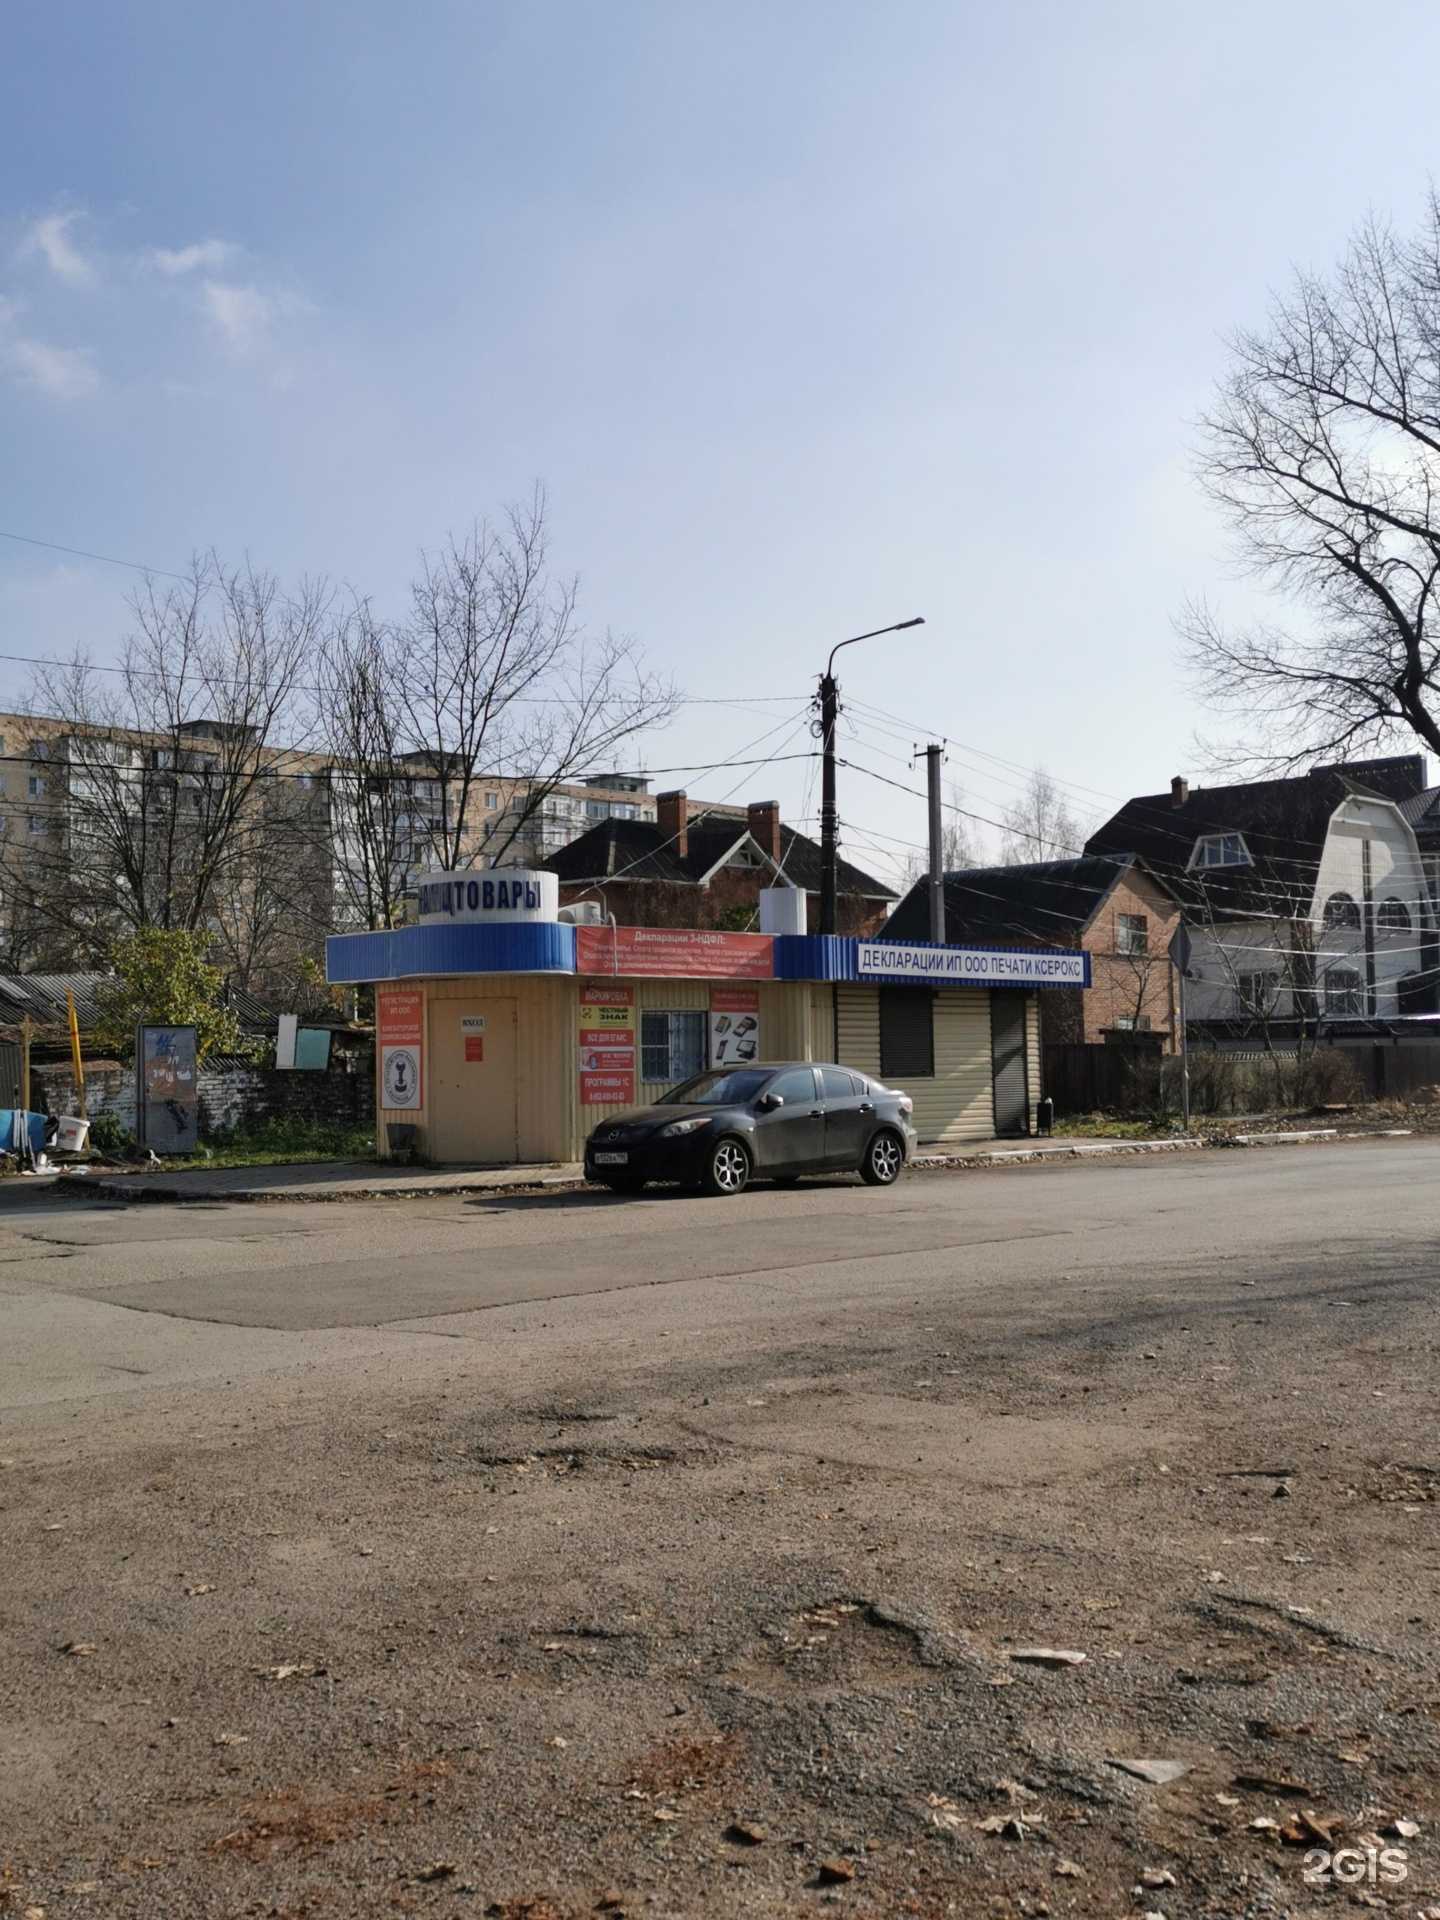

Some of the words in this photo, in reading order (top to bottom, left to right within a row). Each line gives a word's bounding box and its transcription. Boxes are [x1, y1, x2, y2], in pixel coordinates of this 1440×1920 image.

[634, 931, 689, 944] Декларации
[862, 949, 944, 972] ДЕКЛАРАЦИИ
[946, 955, 962, 972] ИП
[965, 956, 988, 973] ООО
[991, 957, 1032, 975] ПЕЧАТИ
[1034, 959, 1081, 977] КСЕРОКС
